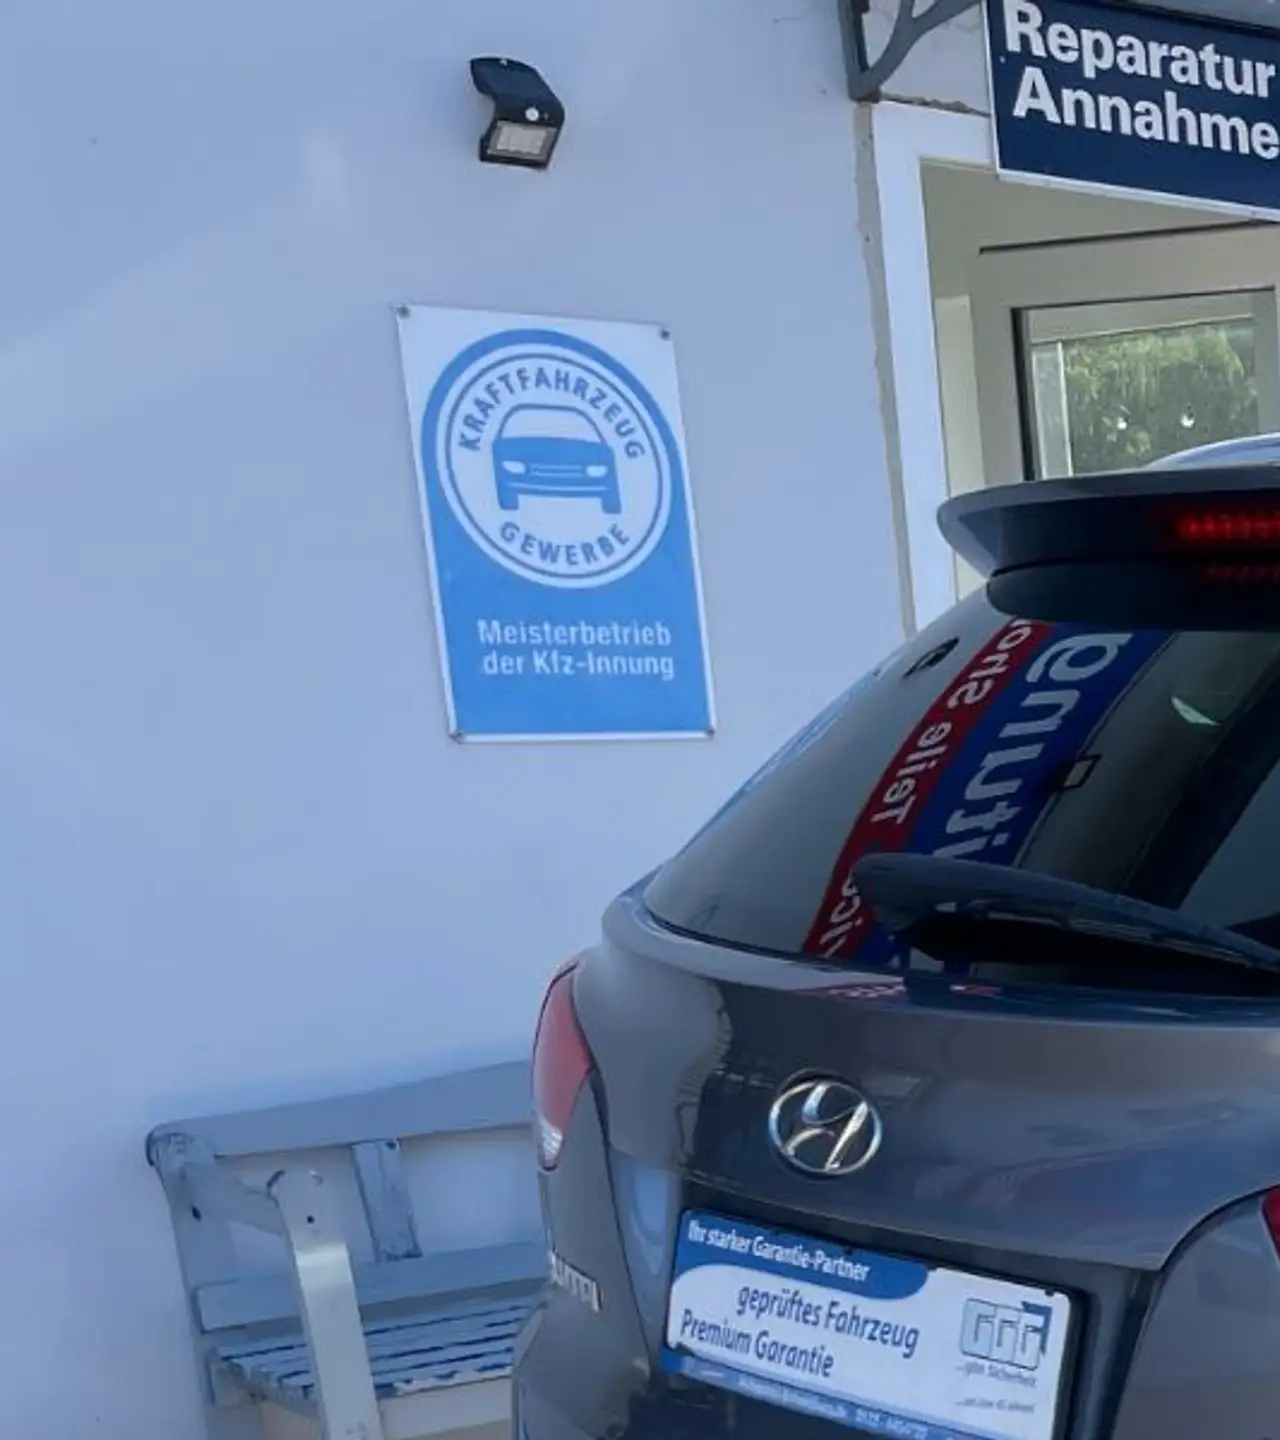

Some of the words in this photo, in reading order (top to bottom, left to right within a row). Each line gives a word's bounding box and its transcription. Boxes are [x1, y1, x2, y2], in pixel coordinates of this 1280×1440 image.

[1004, 0, 1275, 98] Reparatur
[1012, 66, 1280, 160] Annahme
[458, 365, 645, 461] KRAFTFAHRZEUG
[500, 520, 631, 567] GEWERBE
[476, 619, 672, 648] Meisterbetrieb
[483, 650, 524, 676] der
[532, 648, 675, 681] Kfz-Innung
[688, 1219, 707, 1245] Ihr
[707, 1227, 753, 1255] starker
[752, 1234, 871, 1282] Garantie-Partner
[680, 1309, 752, 1354] Premium
[754, 1330, 835, 1378] Garantie
[736, 1285, 823, 1328] geprüftes
[824, 1300, 920, 1360] Fahrzeug
